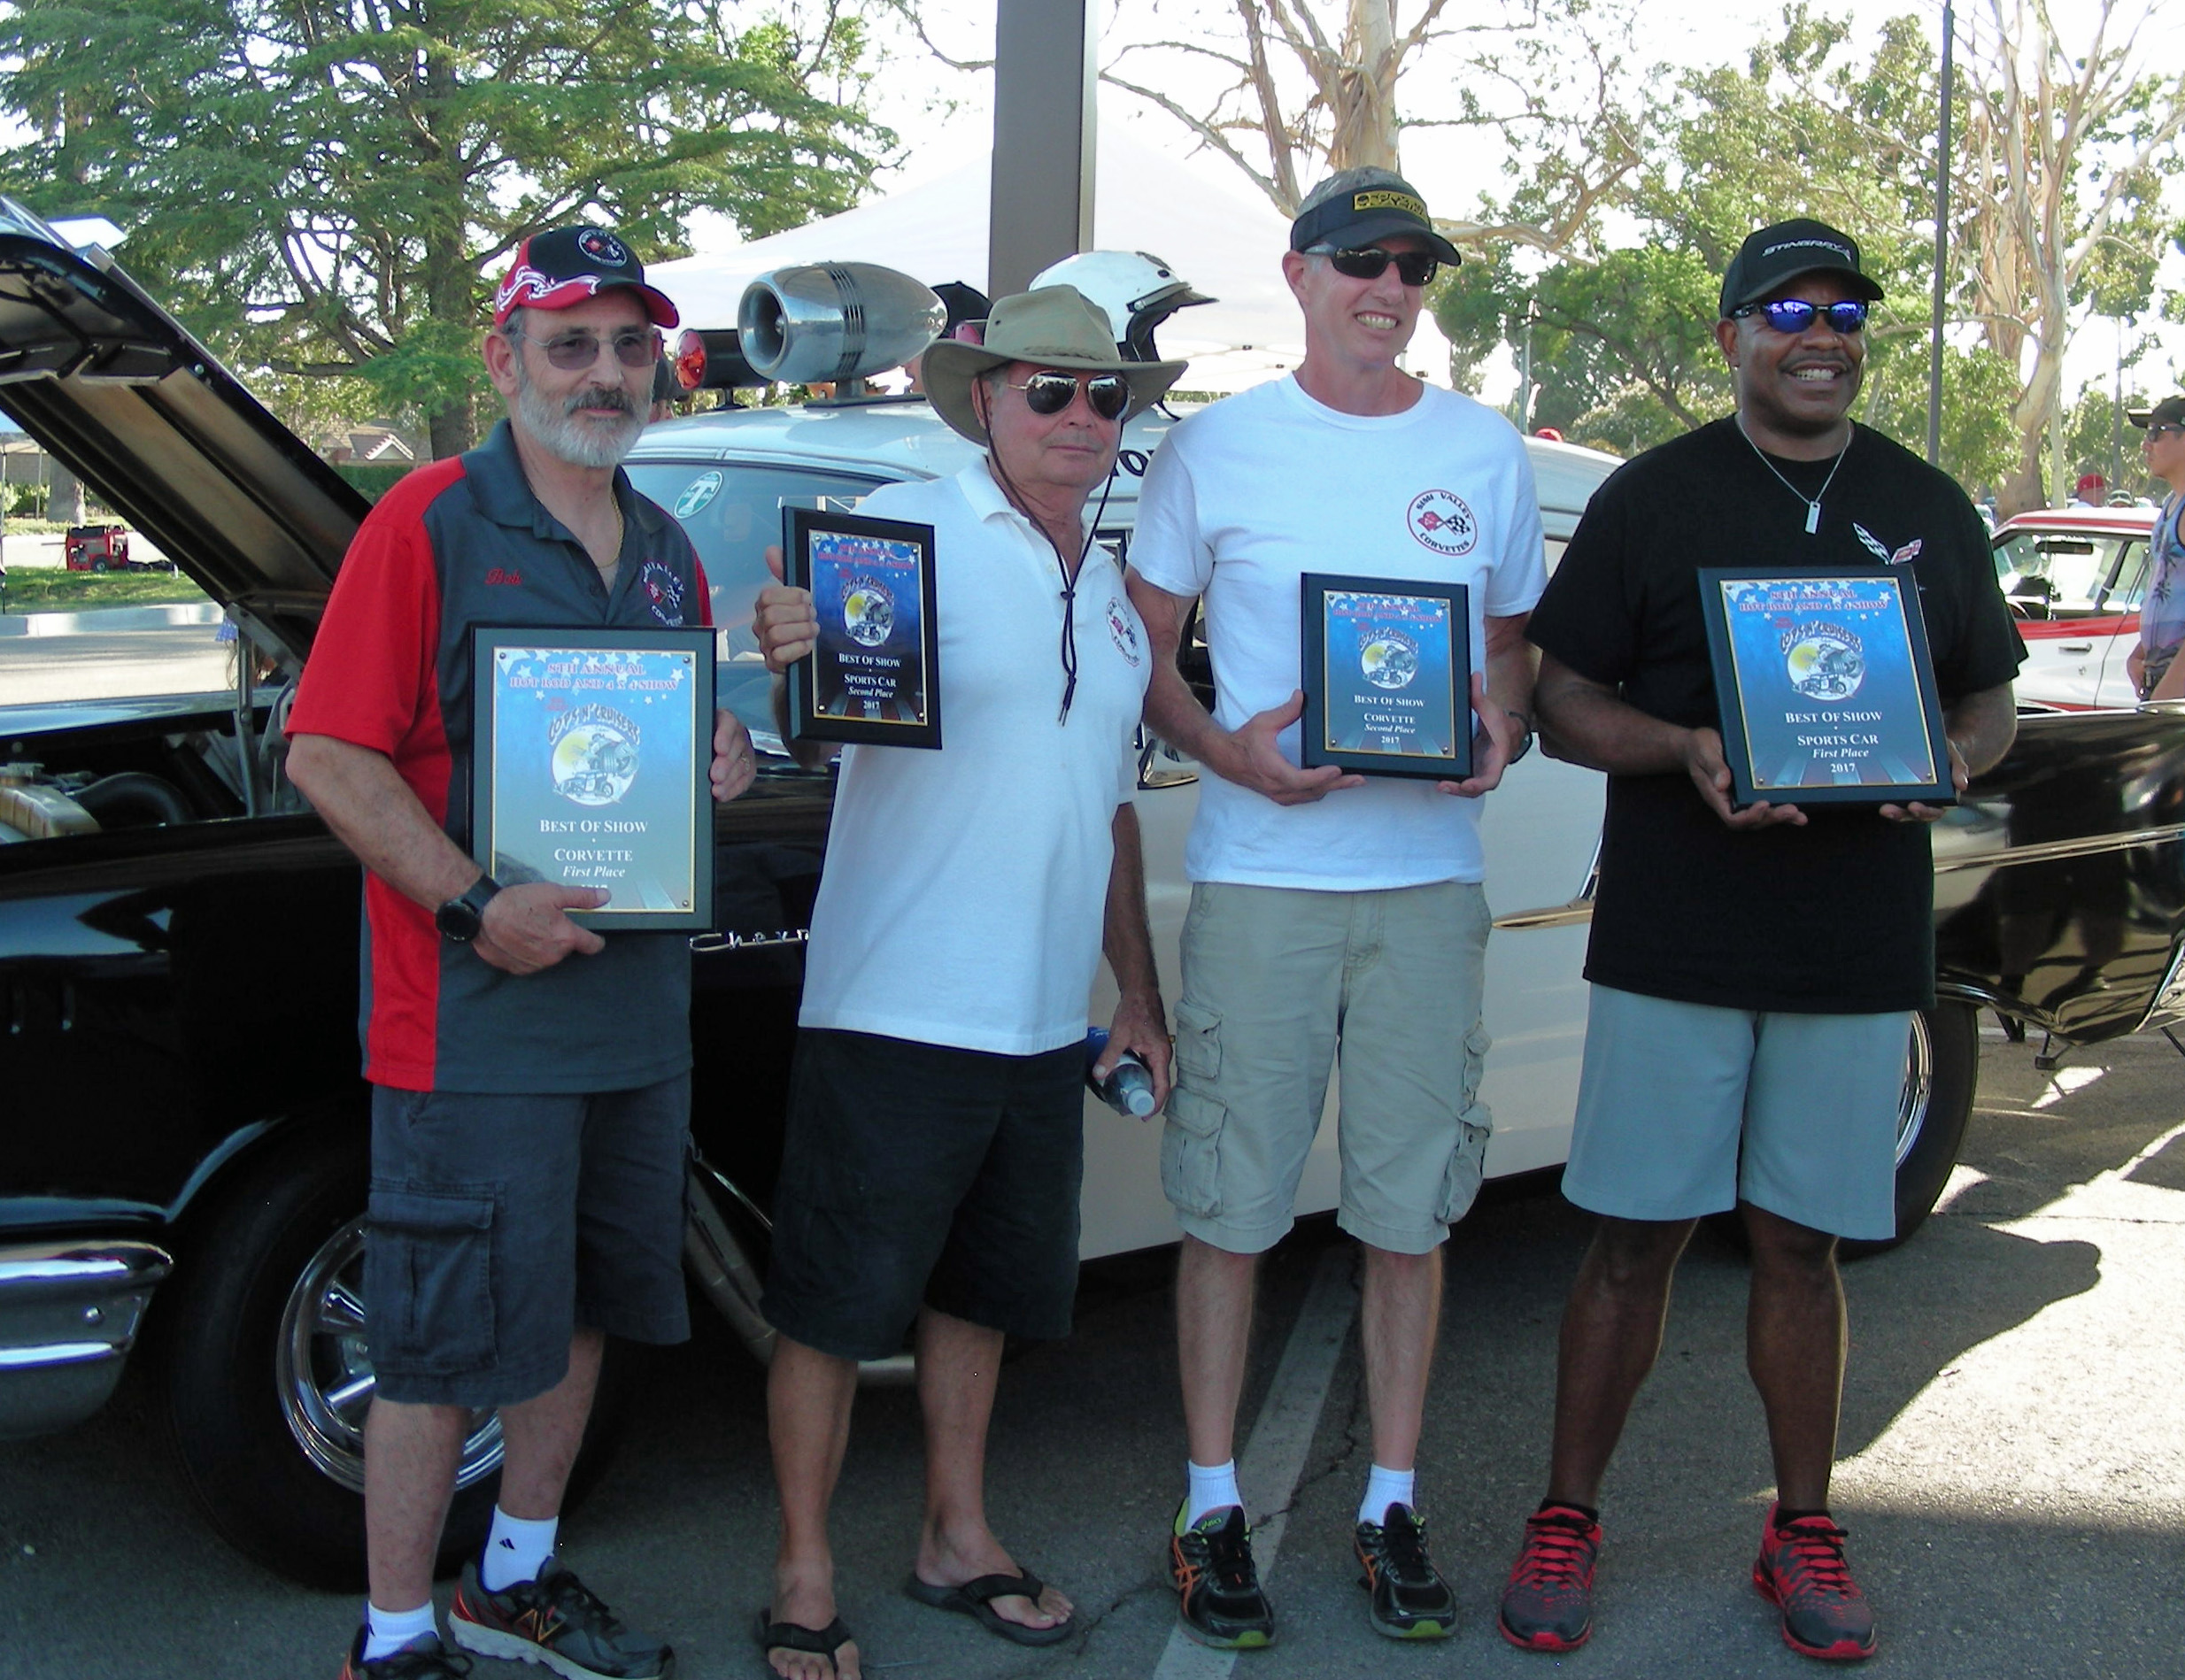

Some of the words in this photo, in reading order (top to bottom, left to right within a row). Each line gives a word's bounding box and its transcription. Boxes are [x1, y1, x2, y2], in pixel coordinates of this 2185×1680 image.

[1417, 493, 1434, 510] SIMI
[1440, 492, 1471, 520] VALLEY
[1419, 532, 1470, 553] CORVETTES
[838, 653, 860, 664] BEST
[861, 655, 875, 665] OF
[875, 657, 901, 667] SHOW
[581, 664, 646, 675] ANNUAL
[510, 677, 537, 688] HOT
[541, 678, 570, 688] ROD
[572, 678, 604, 690] AND
[638, 680, 678, 690] SHOW
[844, 674, 876, 686] SPORTS
[878, 676, 897, 687] CAR
[848, 687, 874, 697] Second
[875, 689, 893, 698] Place
[1354, 695, 1378, 705] BEST
[1380, 697, 1395, 705] OF
[1396, 697, 1425, 707] SHOW
[1363, 713, 1416, 724] CORVETTE
[1785, 713, 1818, 723] BEST
[1821, 711, 1841, 722] OF
[1842, 711, 1882, 722] SHOW
[594, 705, 641, 744] CRUISERS
[1364, 724, 1394, 733] Second
[1394, 725, 1416, 734] Place
[1797, 735, 1848, 746] SPORTS
[1849, 734, 1879, 745] CAR
[1813, 748, 1838, 759] First
[1841, 748, 1869, 759] Place
[1830, 763, 1856, 773] 2017
[540, 820, 576, 832] BEST
[580, 820, 602, 832] OF
[604, 820, 648, 833] SHOW
[554, 848, 633, 861] CORVETTE
[562, 866, 591, 877] First
[594, 866, 626, 877] Place
[690, 929, 809, 952] Chevr
